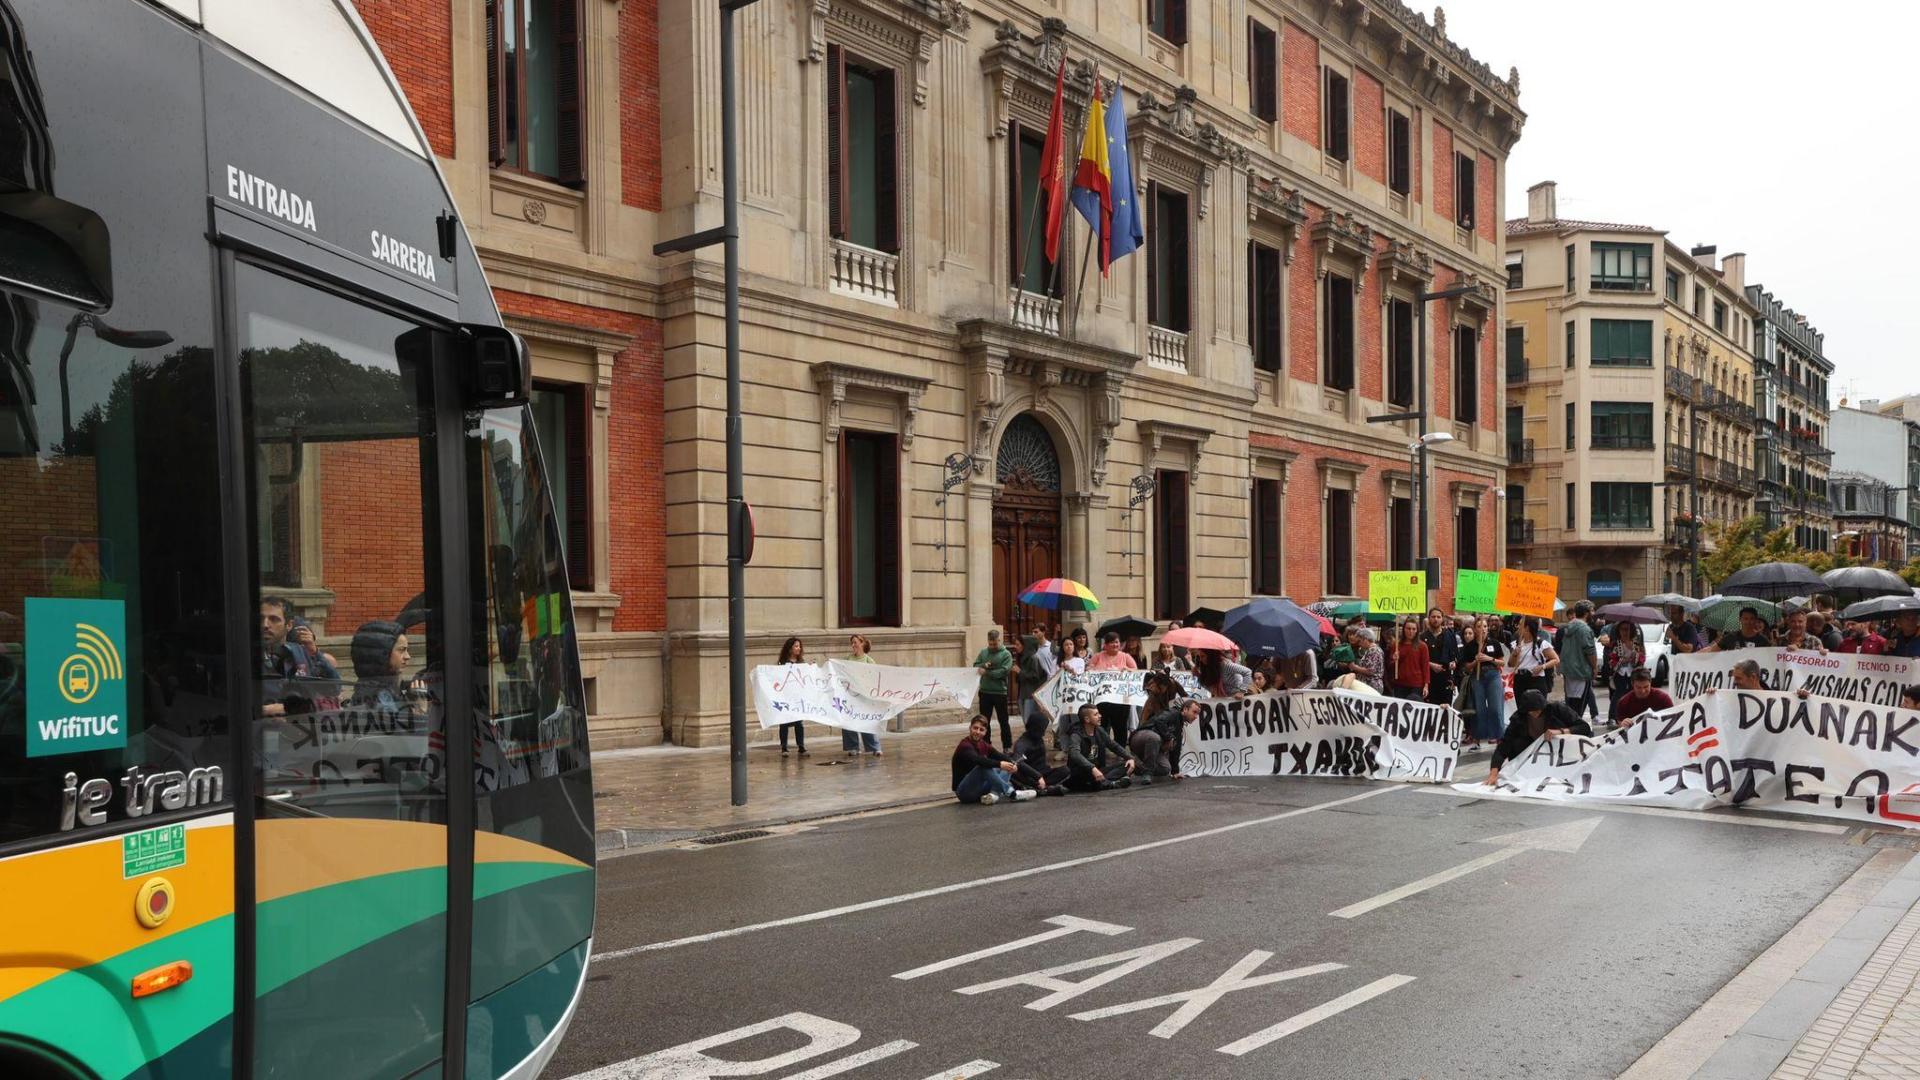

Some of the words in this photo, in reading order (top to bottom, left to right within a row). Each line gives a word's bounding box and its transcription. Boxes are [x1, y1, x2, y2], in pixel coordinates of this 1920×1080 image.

[226, 164, 317, 232] ENTRADA
[370, 230, 436, 283] SARRERA
[1374, 596, 1418, 611] VENENO
[1675, 671, 1723, 702] MISMO
[1857, 661, 1890, 672] TECNICO
[38, 714, 119, 741] WifiTUC
[60, 771, 113, 832] ie
[120, 765, 224, 818] tram
[891, 914, 1416, 1056] TAXI
